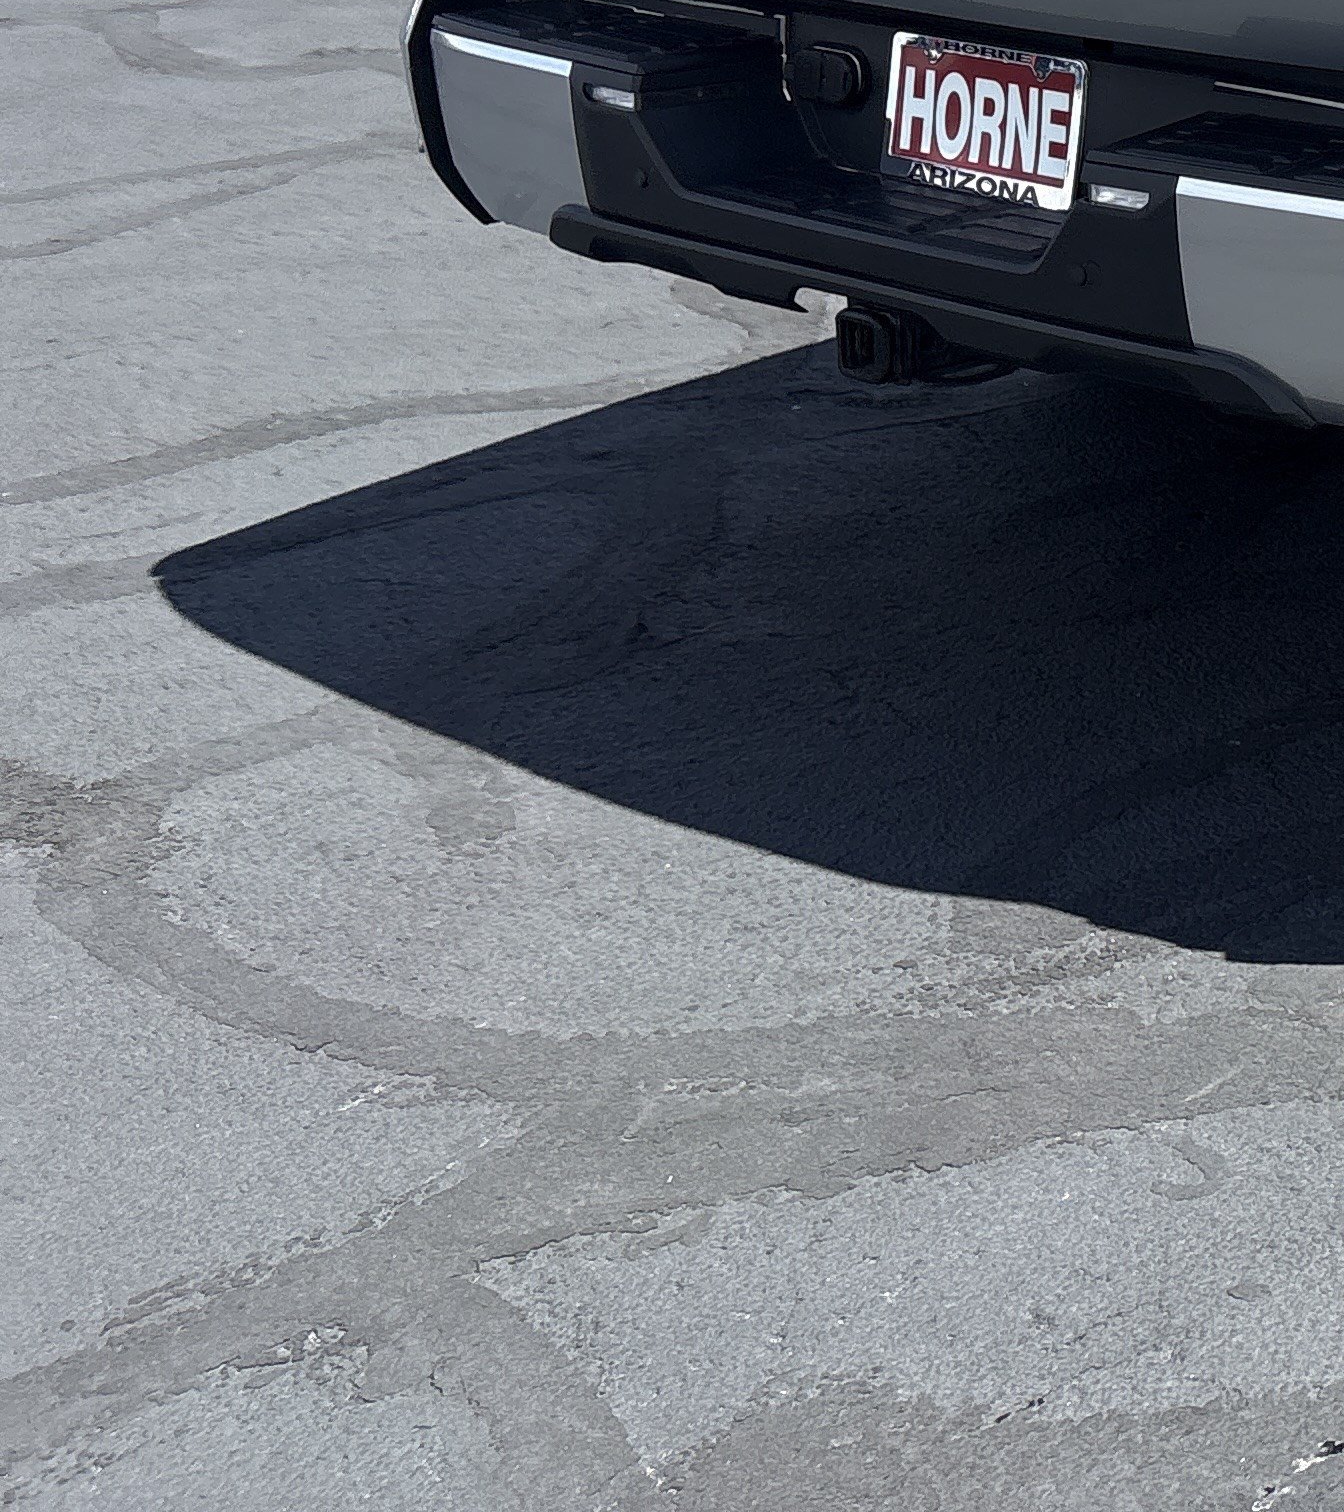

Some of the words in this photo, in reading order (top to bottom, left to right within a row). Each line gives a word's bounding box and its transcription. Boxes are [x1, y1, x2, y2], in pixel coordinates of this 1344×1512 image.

[943, 39, 1033, 64] HORNE
[899, 65, 1071, 180] HORNE
[907, 161, 1040, 207] ARIZONA
